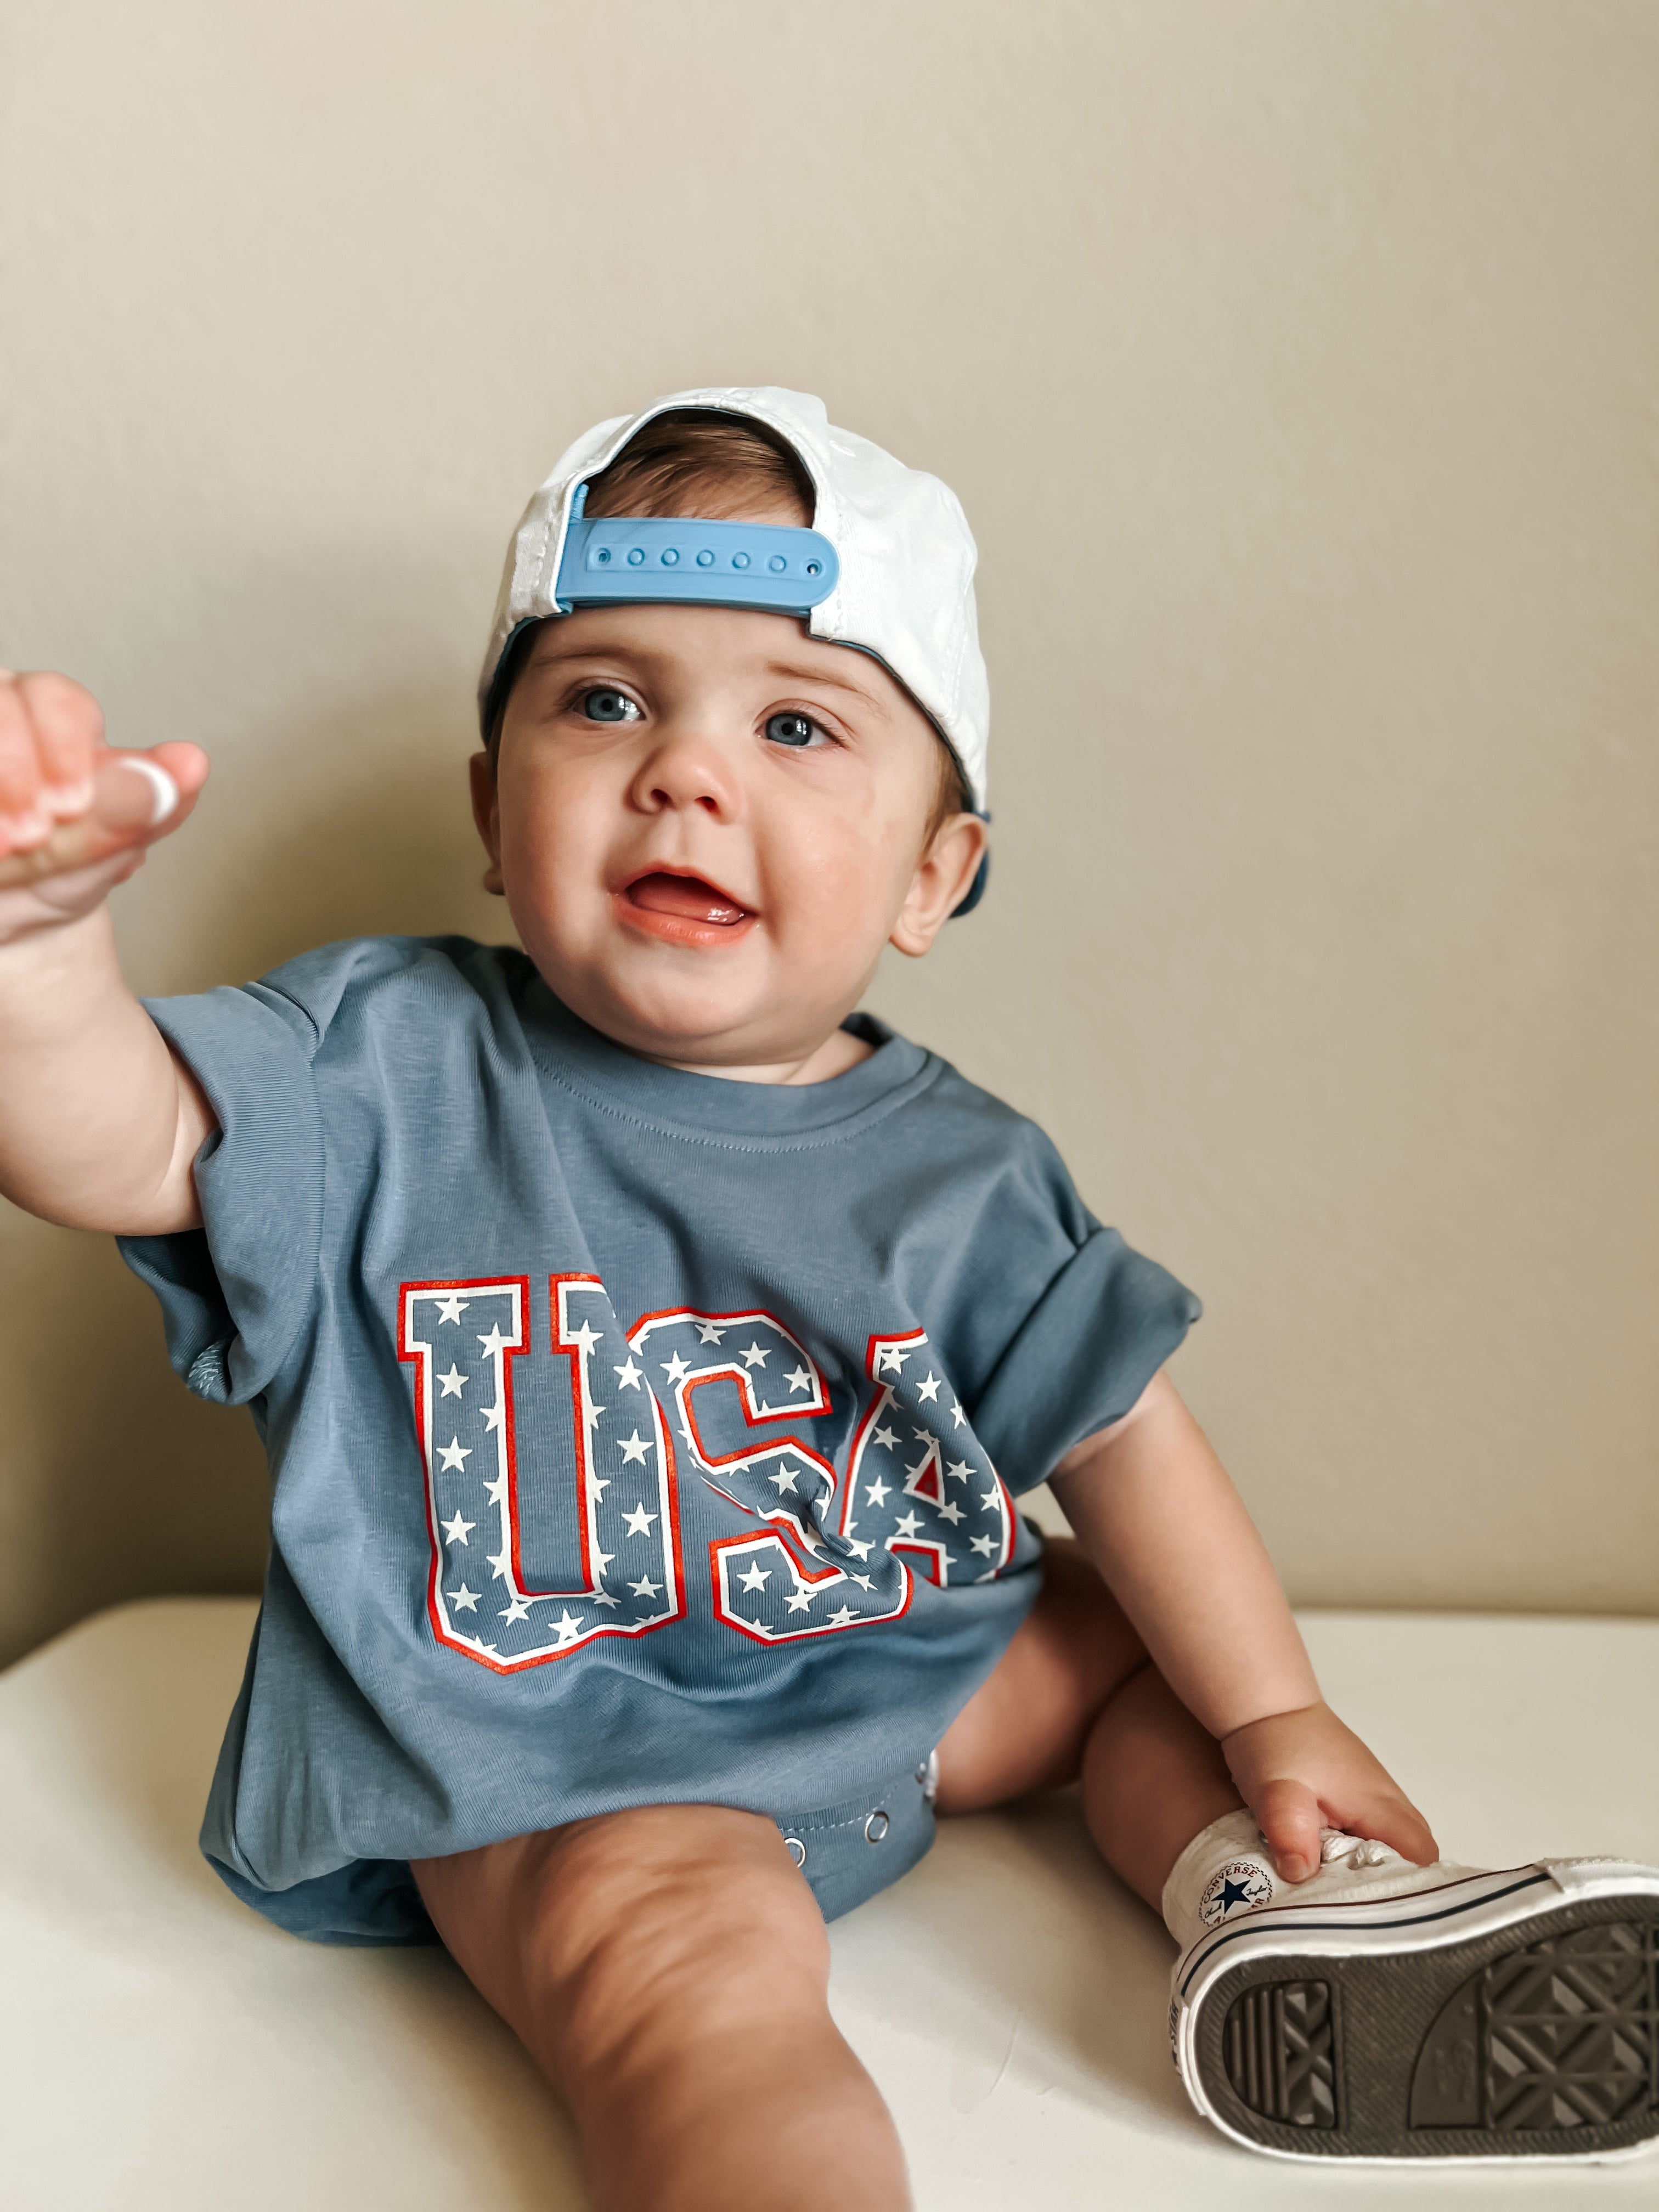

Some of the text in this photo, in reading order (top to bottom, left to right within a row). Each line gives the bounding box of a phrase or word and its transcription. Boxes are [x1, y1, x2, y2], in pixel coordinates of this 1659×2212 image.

[397, 1273, 1017, 1675] USA
[1204, 1866, 1258, 1904] CONVERSE
[1246, 1884, 1267, 1896] Taylor
